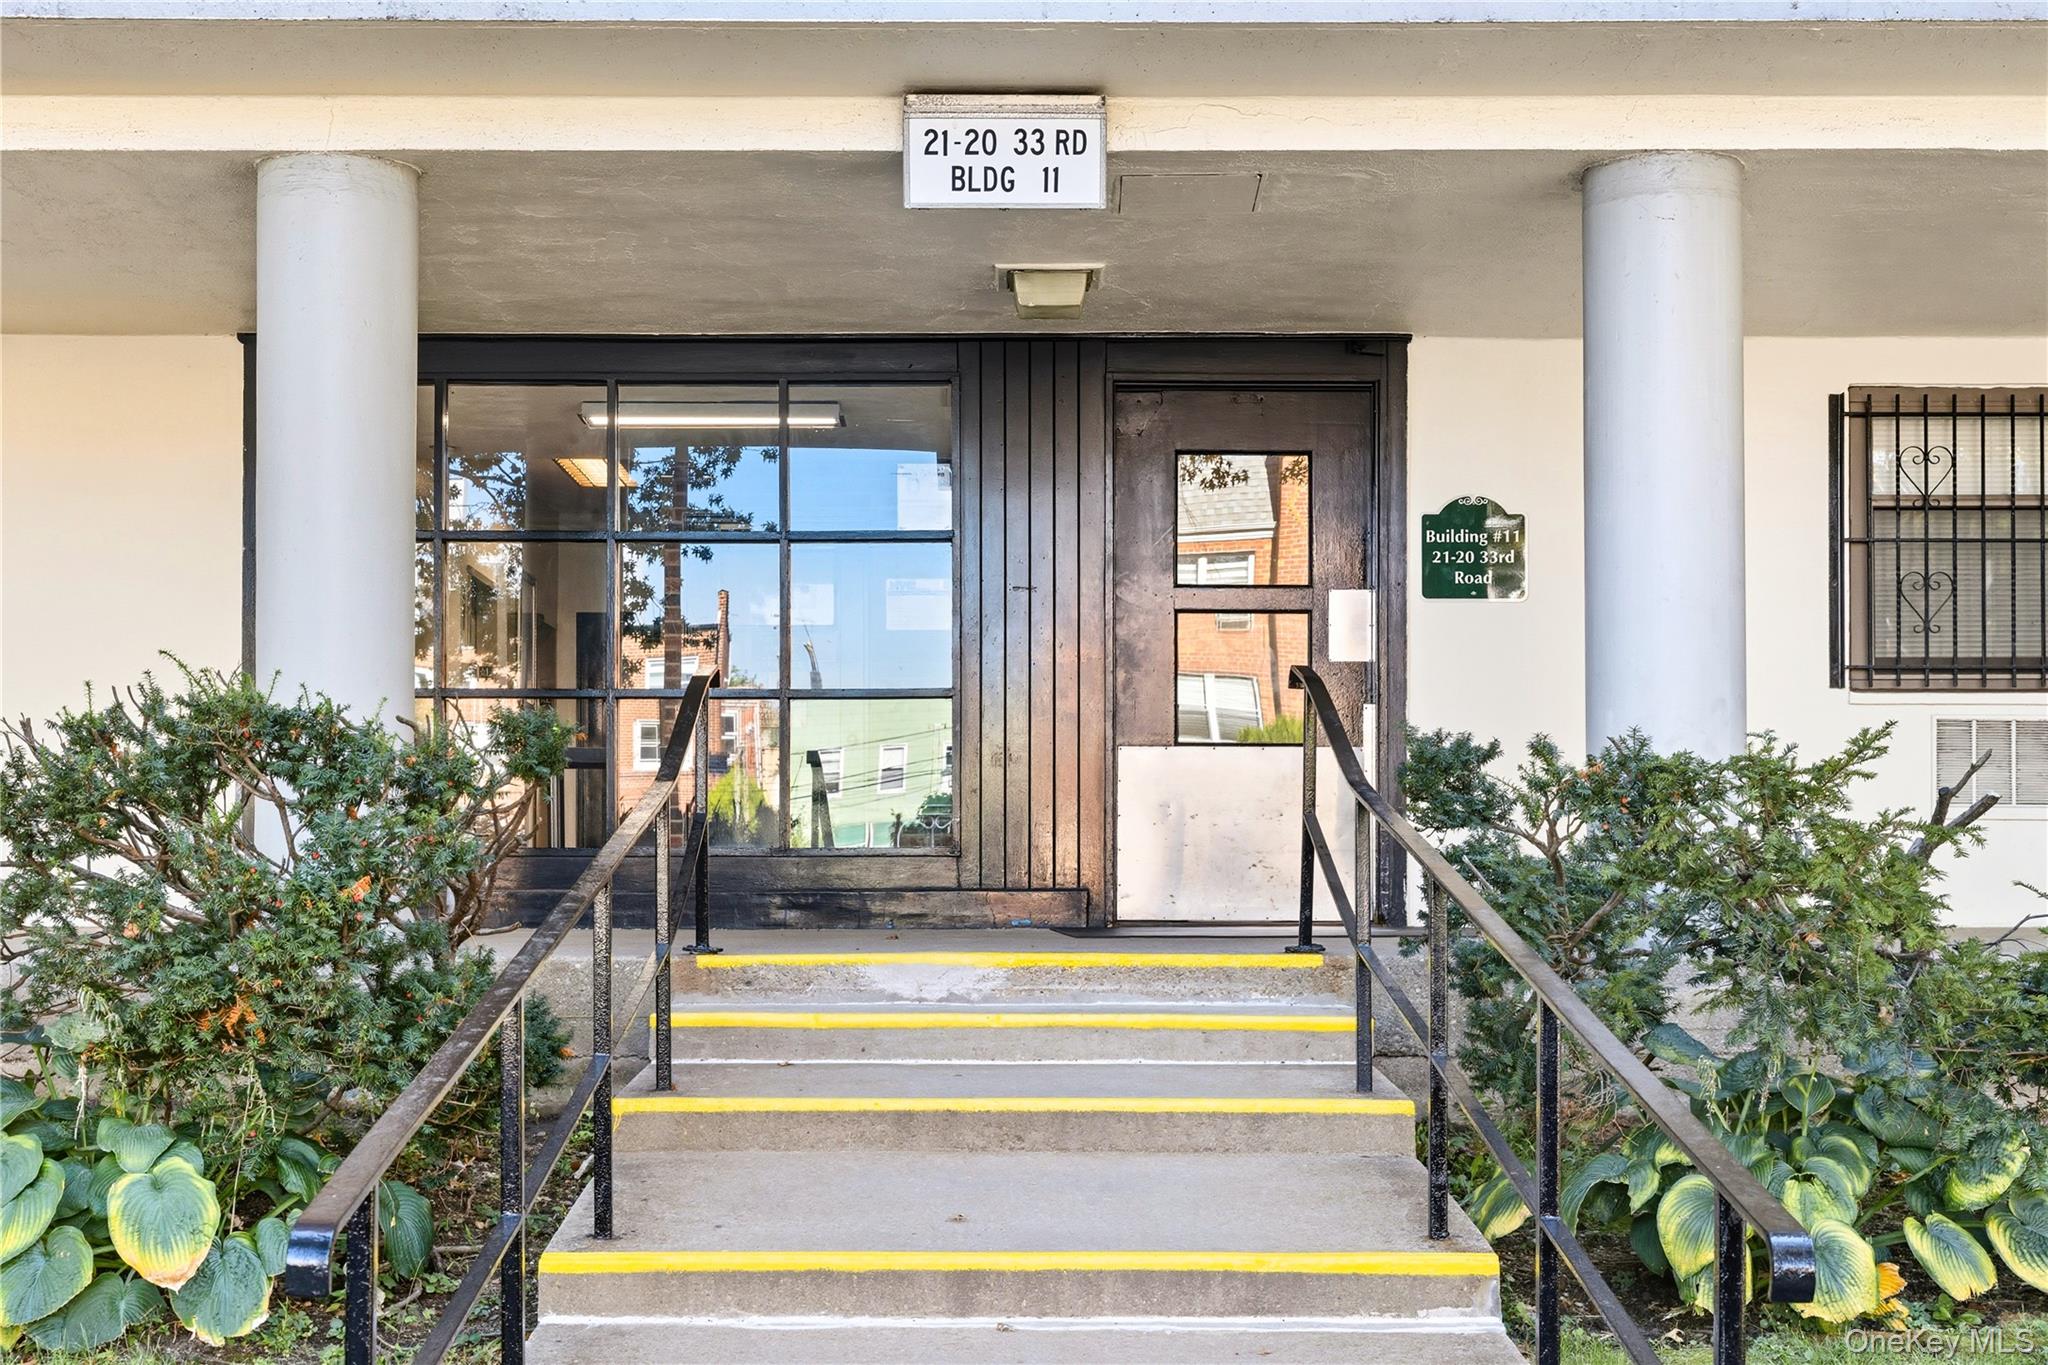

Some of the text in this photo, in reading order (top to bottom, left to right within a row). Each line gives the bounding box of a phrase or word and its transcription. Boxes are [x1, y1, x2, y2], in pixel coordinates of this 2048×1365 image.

[923, 128, 1088, 156] 21-20 33 RD
[951, 165, 1059, 193] BLDG 11
[1426, 529, 1520, 546] Building #11
[1432, 549, 1515, 564] 21-20 33rd
[1454, 569, 1493, 584] Road
